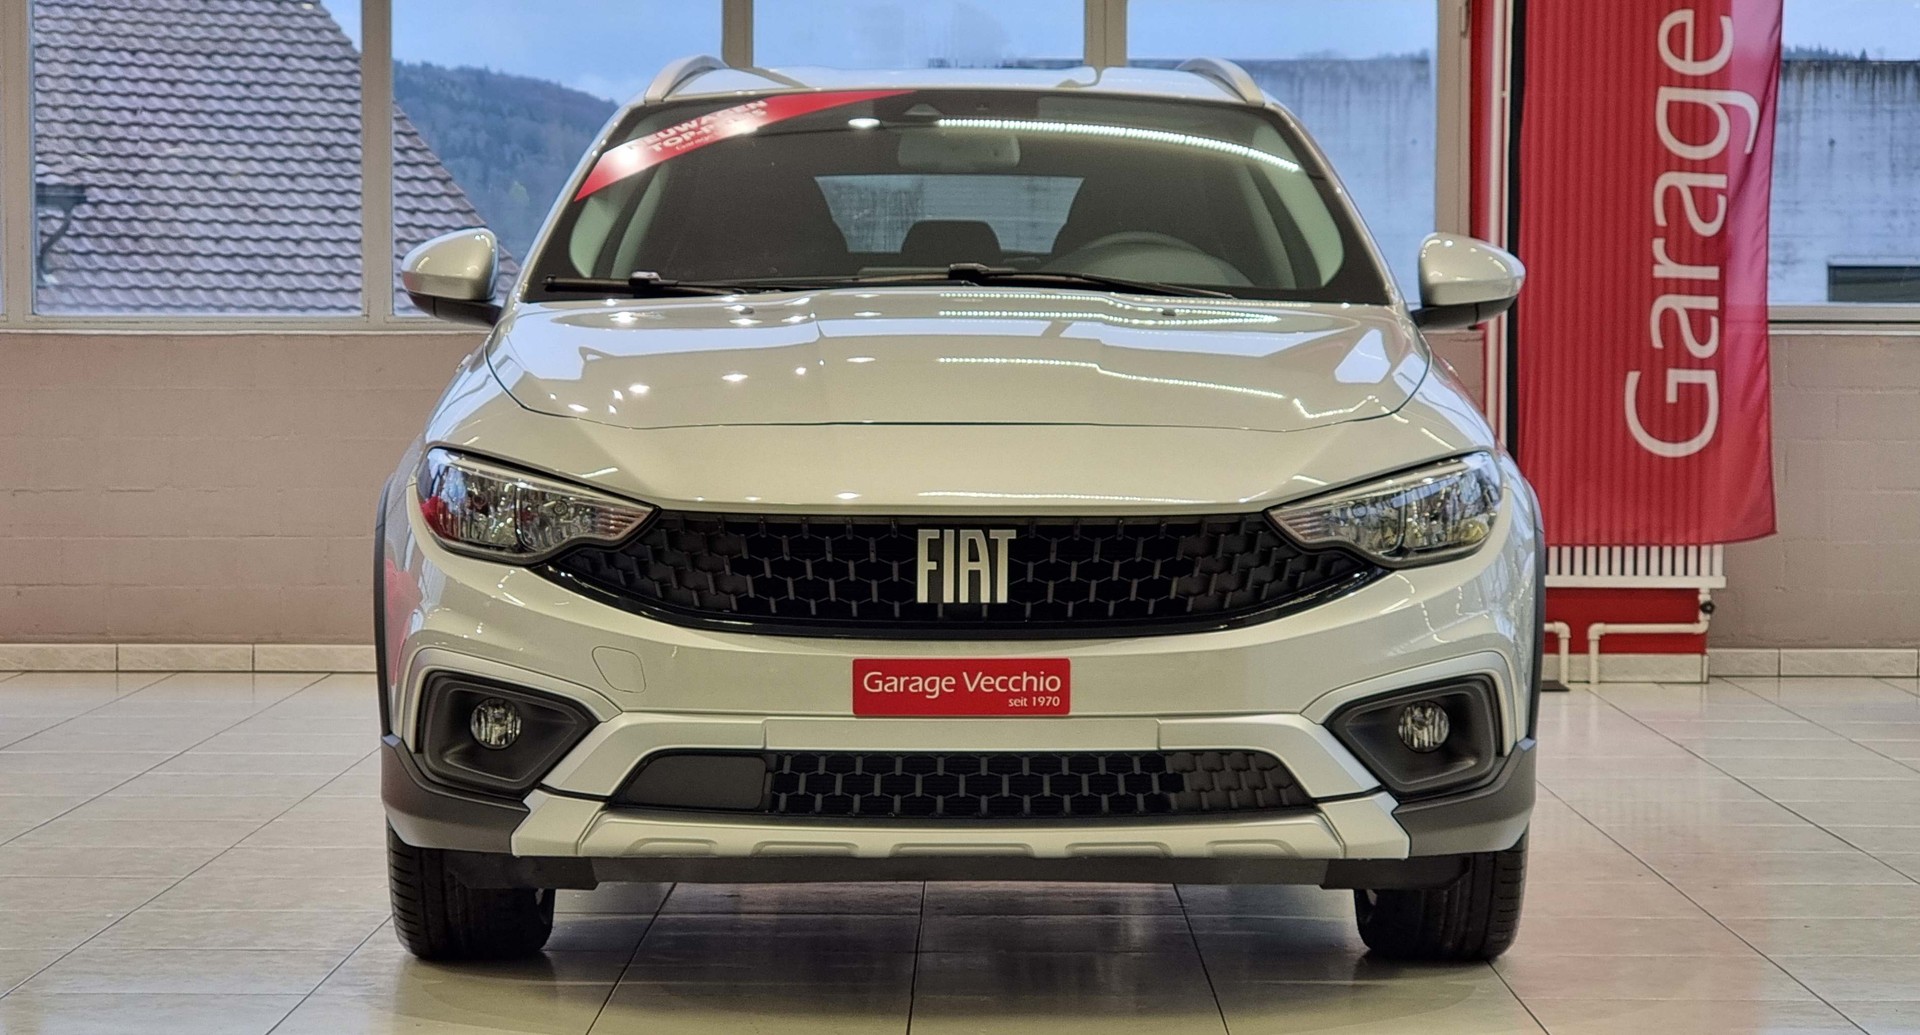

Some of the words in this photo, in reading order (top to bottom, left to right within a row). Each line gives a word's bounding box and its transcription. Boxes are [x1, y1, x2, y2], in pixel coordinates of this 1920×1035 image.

[1624, 8, 1760, 458] Garage
[917, 529, 1017, 603] FIAT
[863, 671, 956, 699] Garage
[962, 671, 1062, 693] Vecchio
[1008, 697, 1028, 707] seit
[1032, 696, 1060, 707] 1970
